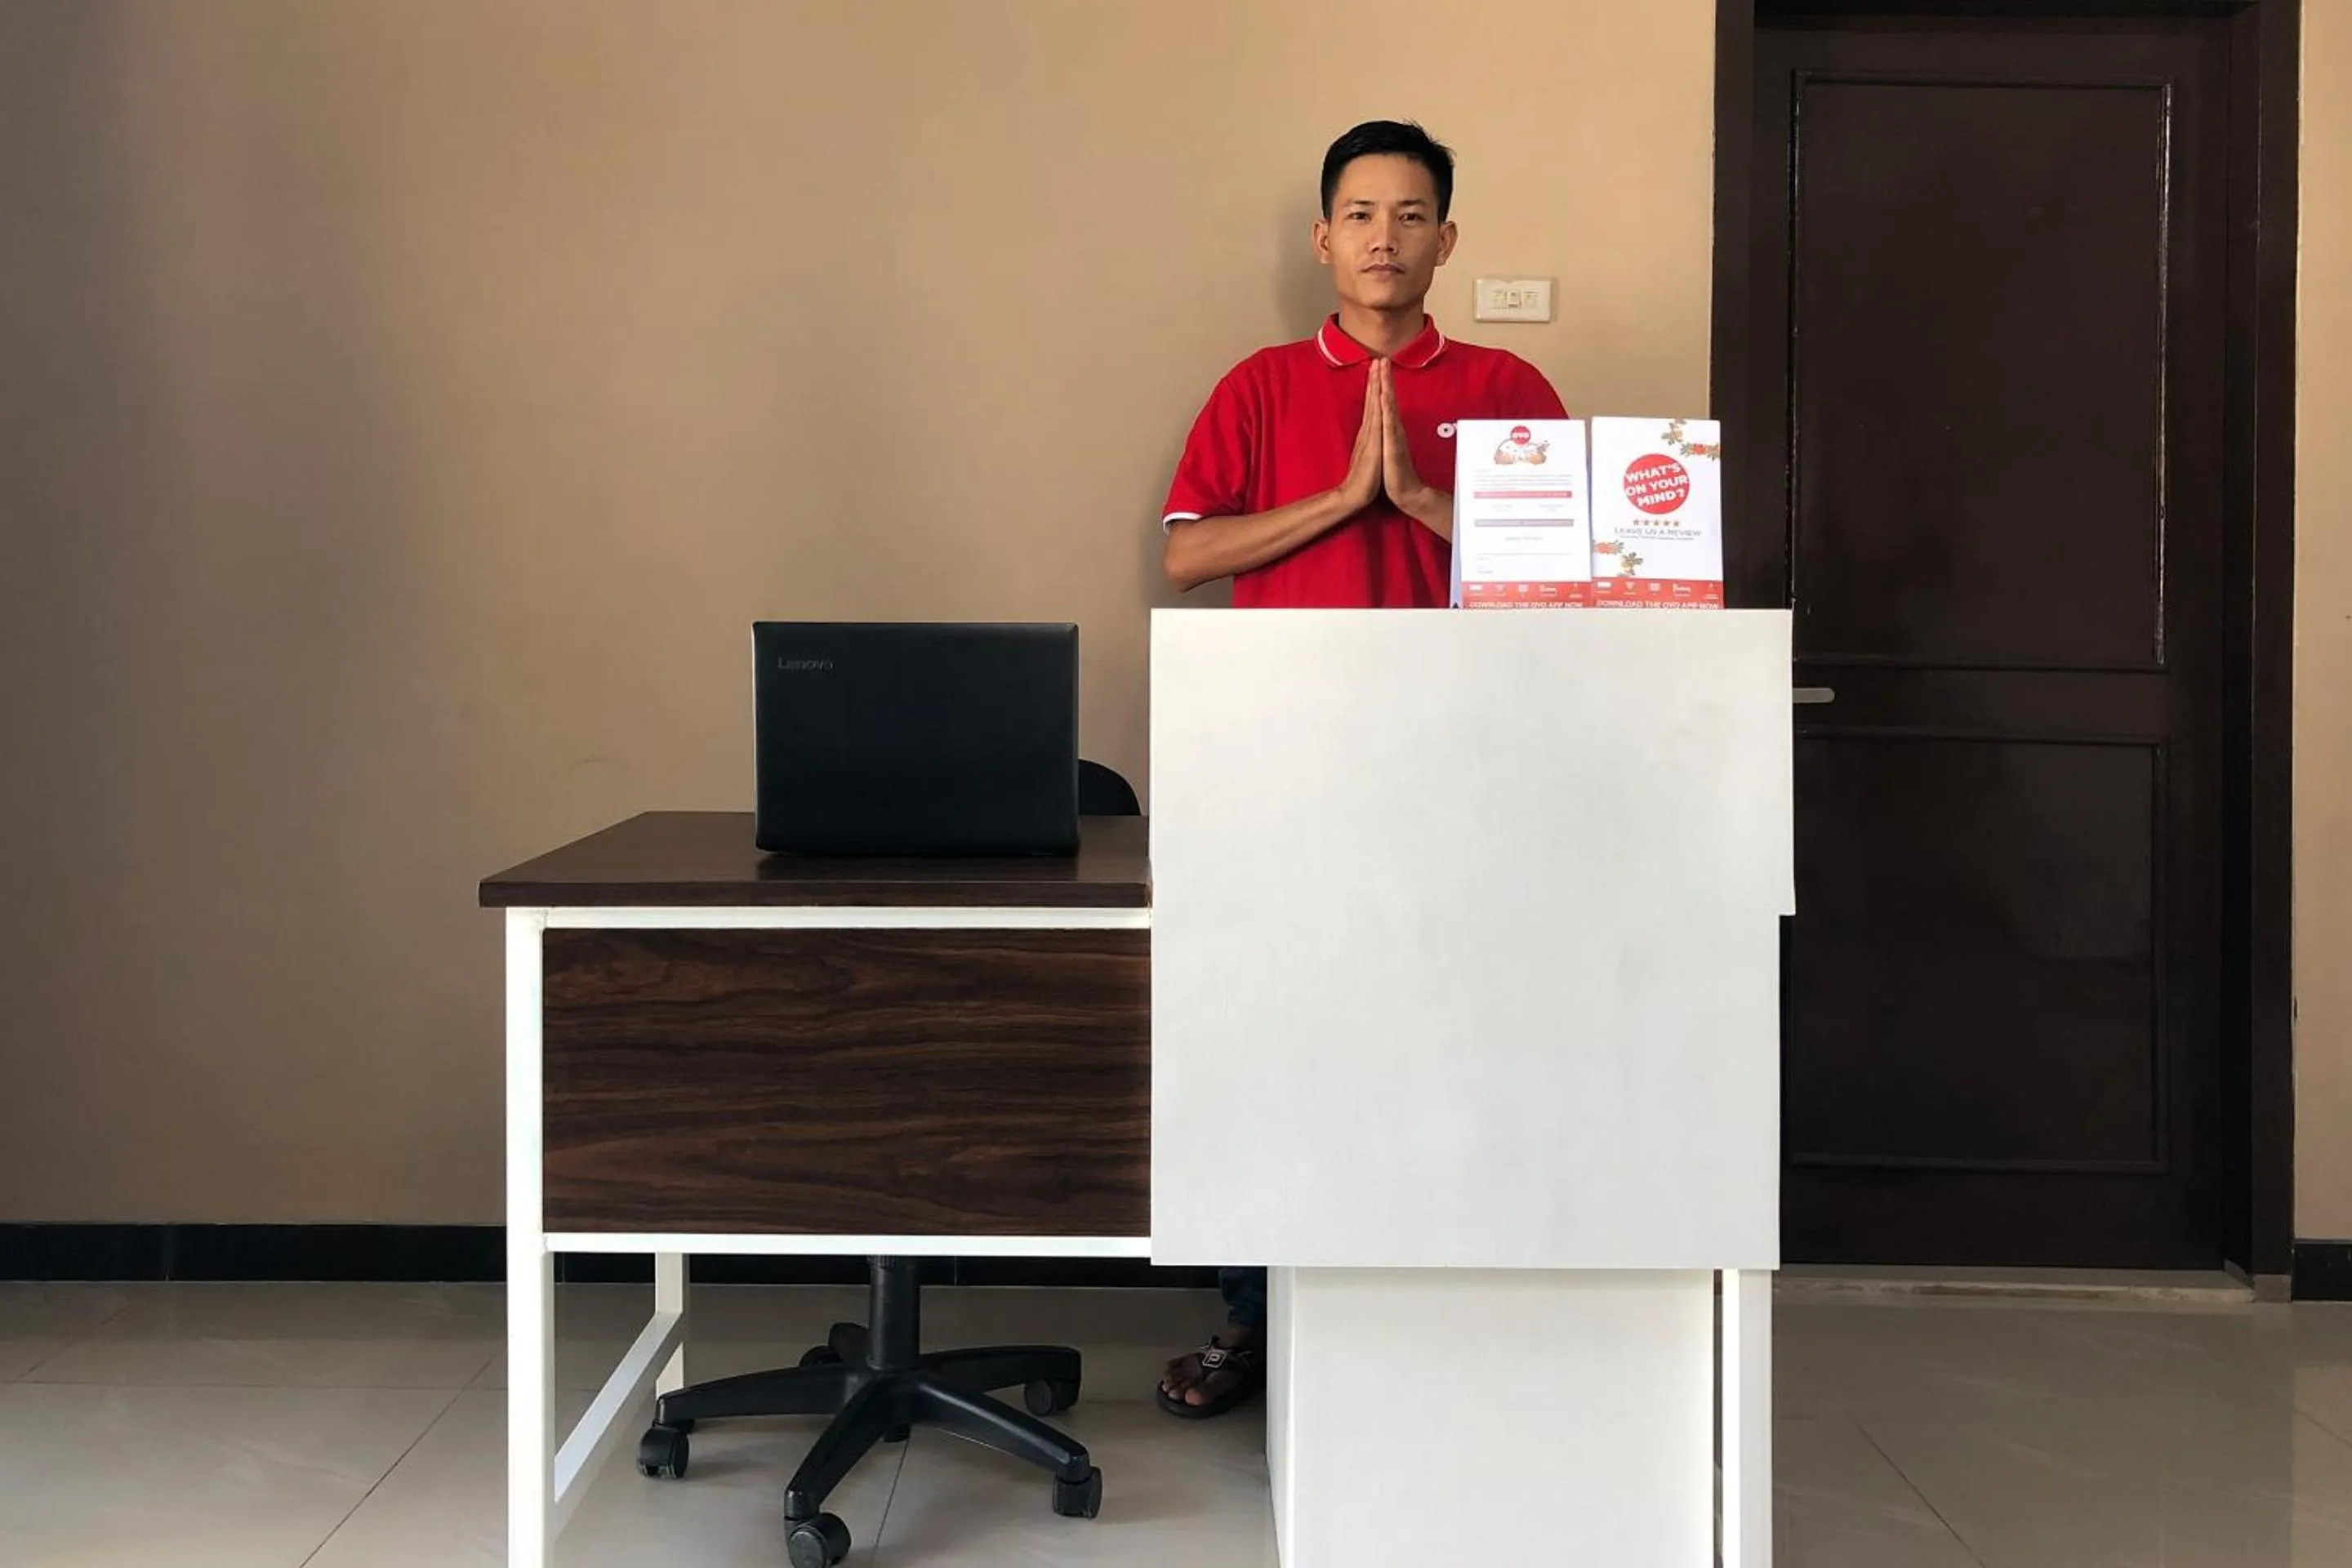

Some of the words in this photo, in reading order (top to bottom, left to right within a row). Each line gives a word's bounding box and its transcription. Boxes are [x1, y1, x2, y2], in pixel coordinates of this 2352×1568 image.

[1625, 462, 1682, 483] WHAT'S
[1625, 483, 1647, 497] ON
[1649, 474, 1688, 492] YOUR
[1637, 488, 1685, 507] MIND?
[1615, 527, 1642, 535] LEAVE
[1596, 599, 1642, 608] DOWNLOAD
[1646, 600, 1660, 608] THE
[777, 656, 834, 670] Lenovo
